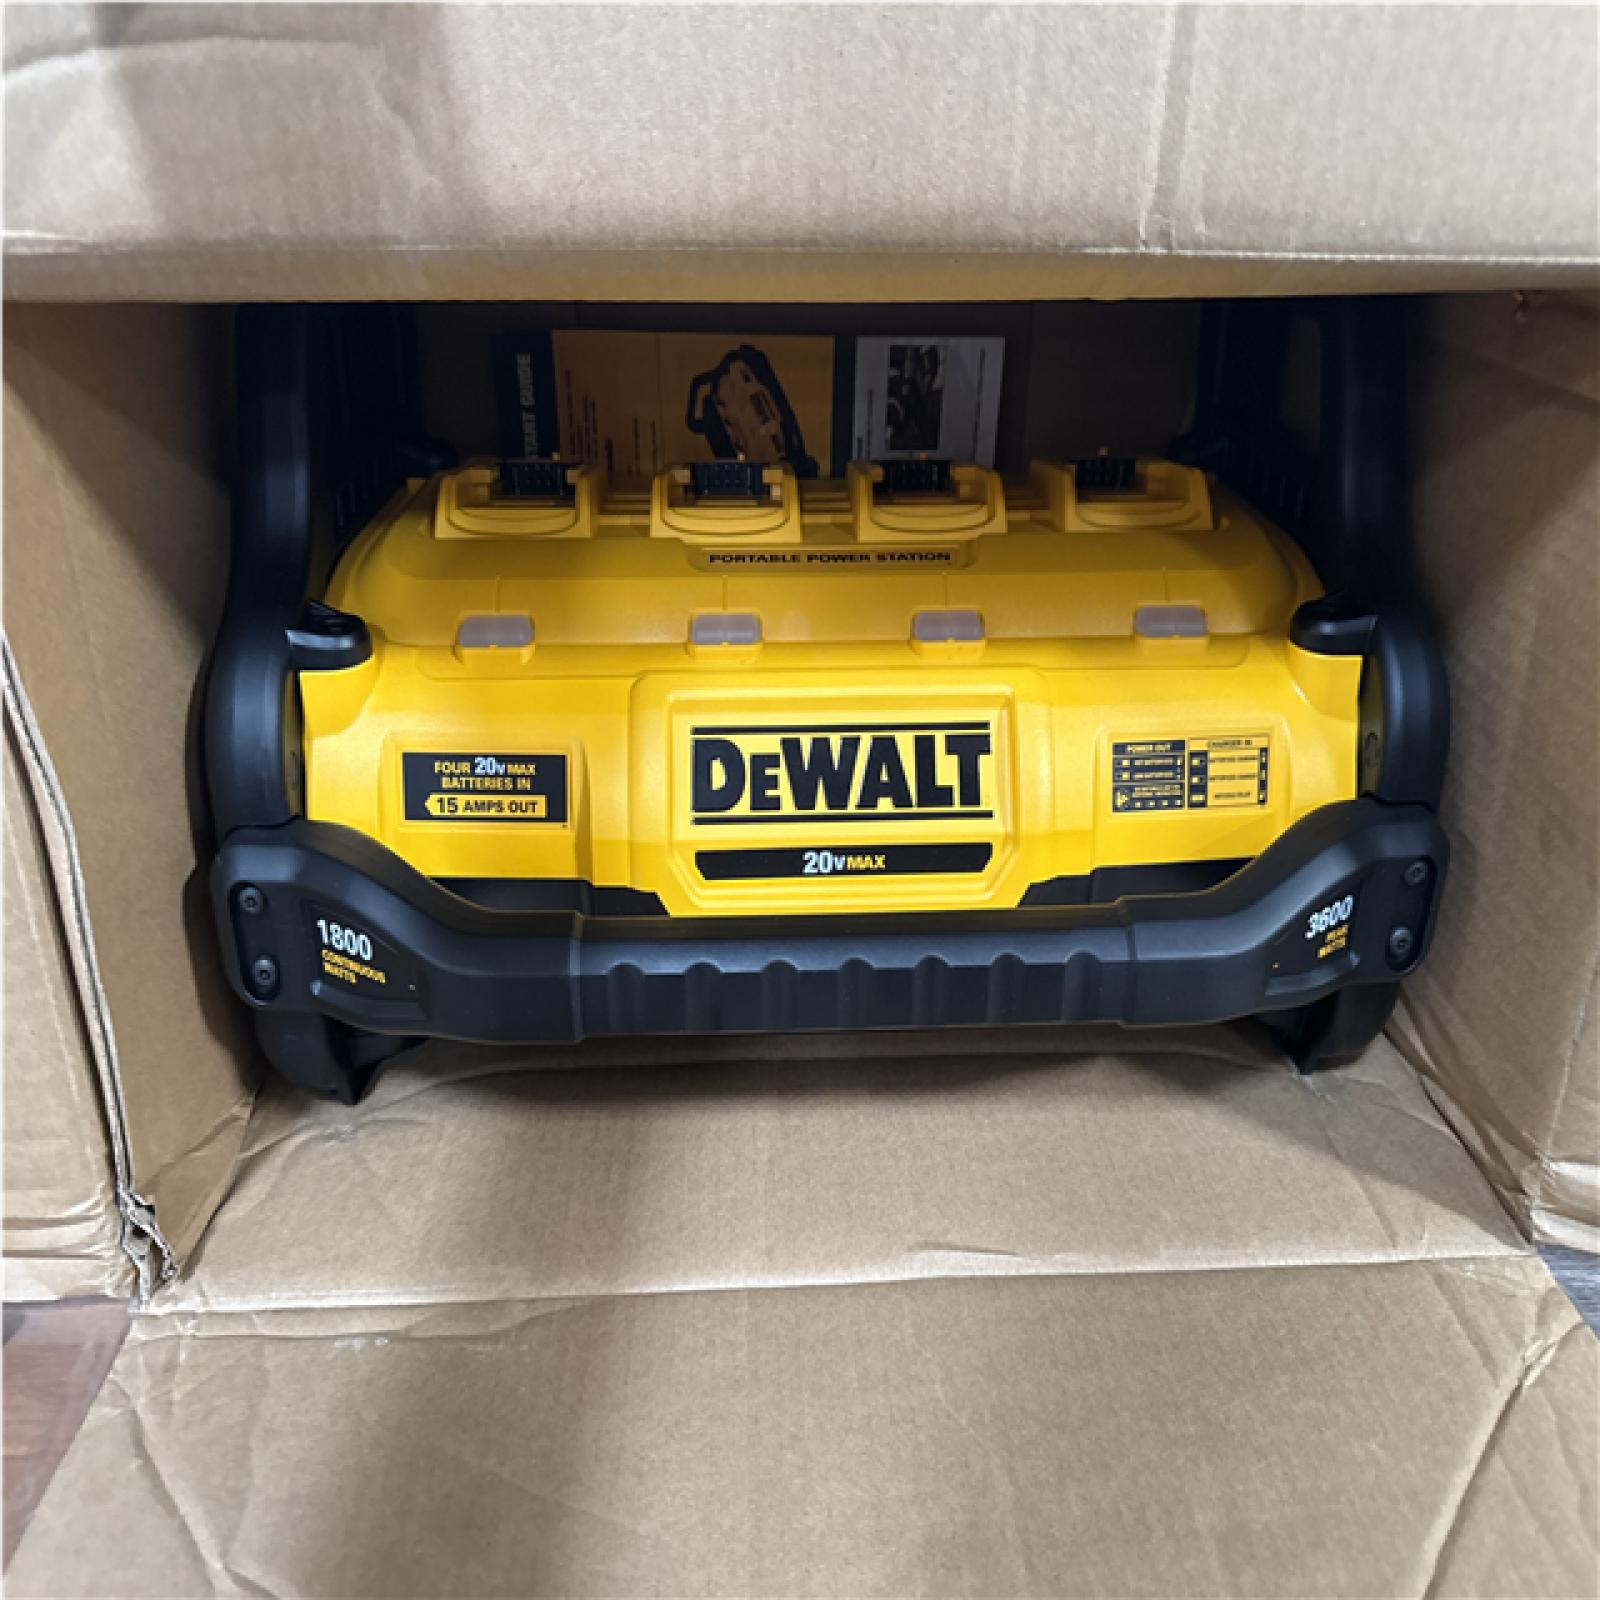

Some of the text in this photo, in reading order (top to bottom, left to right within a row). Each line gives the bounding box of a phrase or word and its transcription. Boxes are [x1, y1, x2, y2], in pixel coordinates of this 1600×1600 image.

[516, 352, 536, 407] GUIDE
[709, 551, 951, 564] PORTABLE POWER STATION
[434, 760, 472, 775] FOUR
[691, 732, 992, 813] DEWALT
[441, 776, 532, 791] BATTERIES IN
[437, 797, 539, 814] 15 AMPS OUT
[1304, 894, 1354, 939] 3600
[316, 919, 373, 961] 1800
